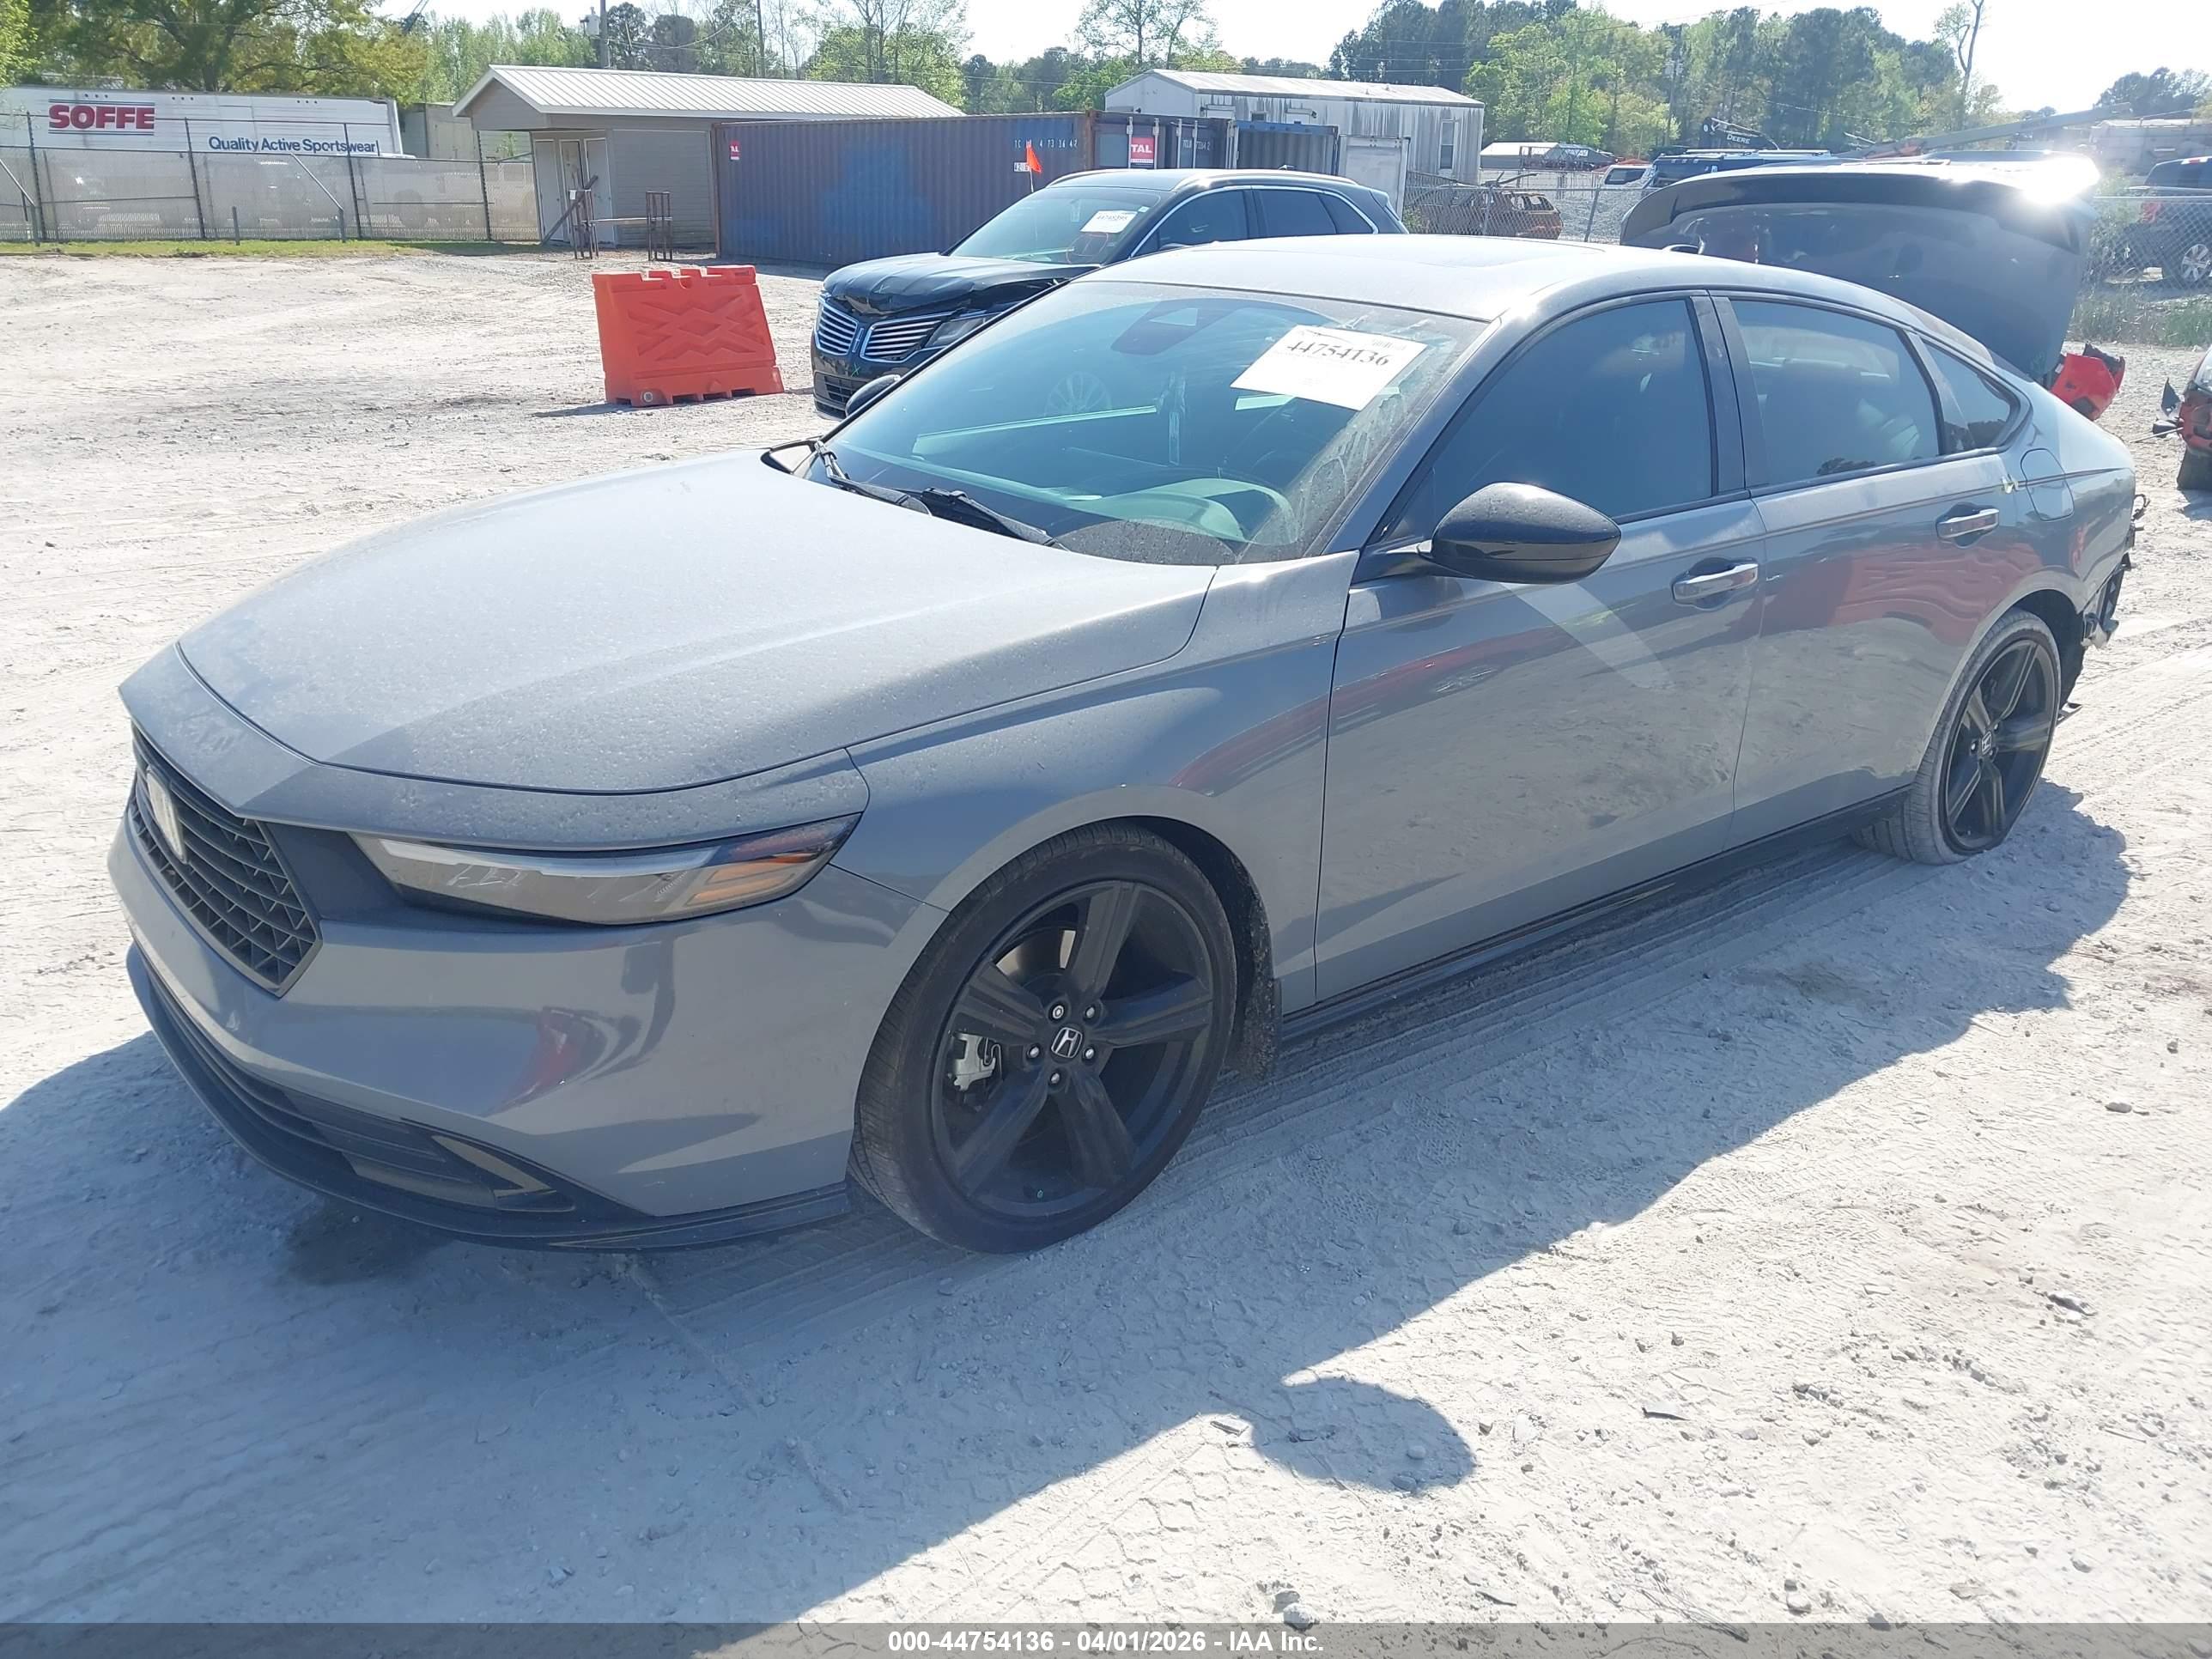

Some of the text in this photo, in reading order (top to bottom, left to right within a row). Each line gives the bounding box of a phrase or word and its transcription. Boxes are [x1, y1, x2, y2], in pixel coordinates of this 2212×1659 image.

[49, 104, 155, 131] SOFFE
[208, 135, 376, 154] Quality Active Sportswear
[1727, 134, 1751, 144] DEERE
[1131, 144, 1153, 154] TAL
[1287, 340, 1394, 366] 44754136
